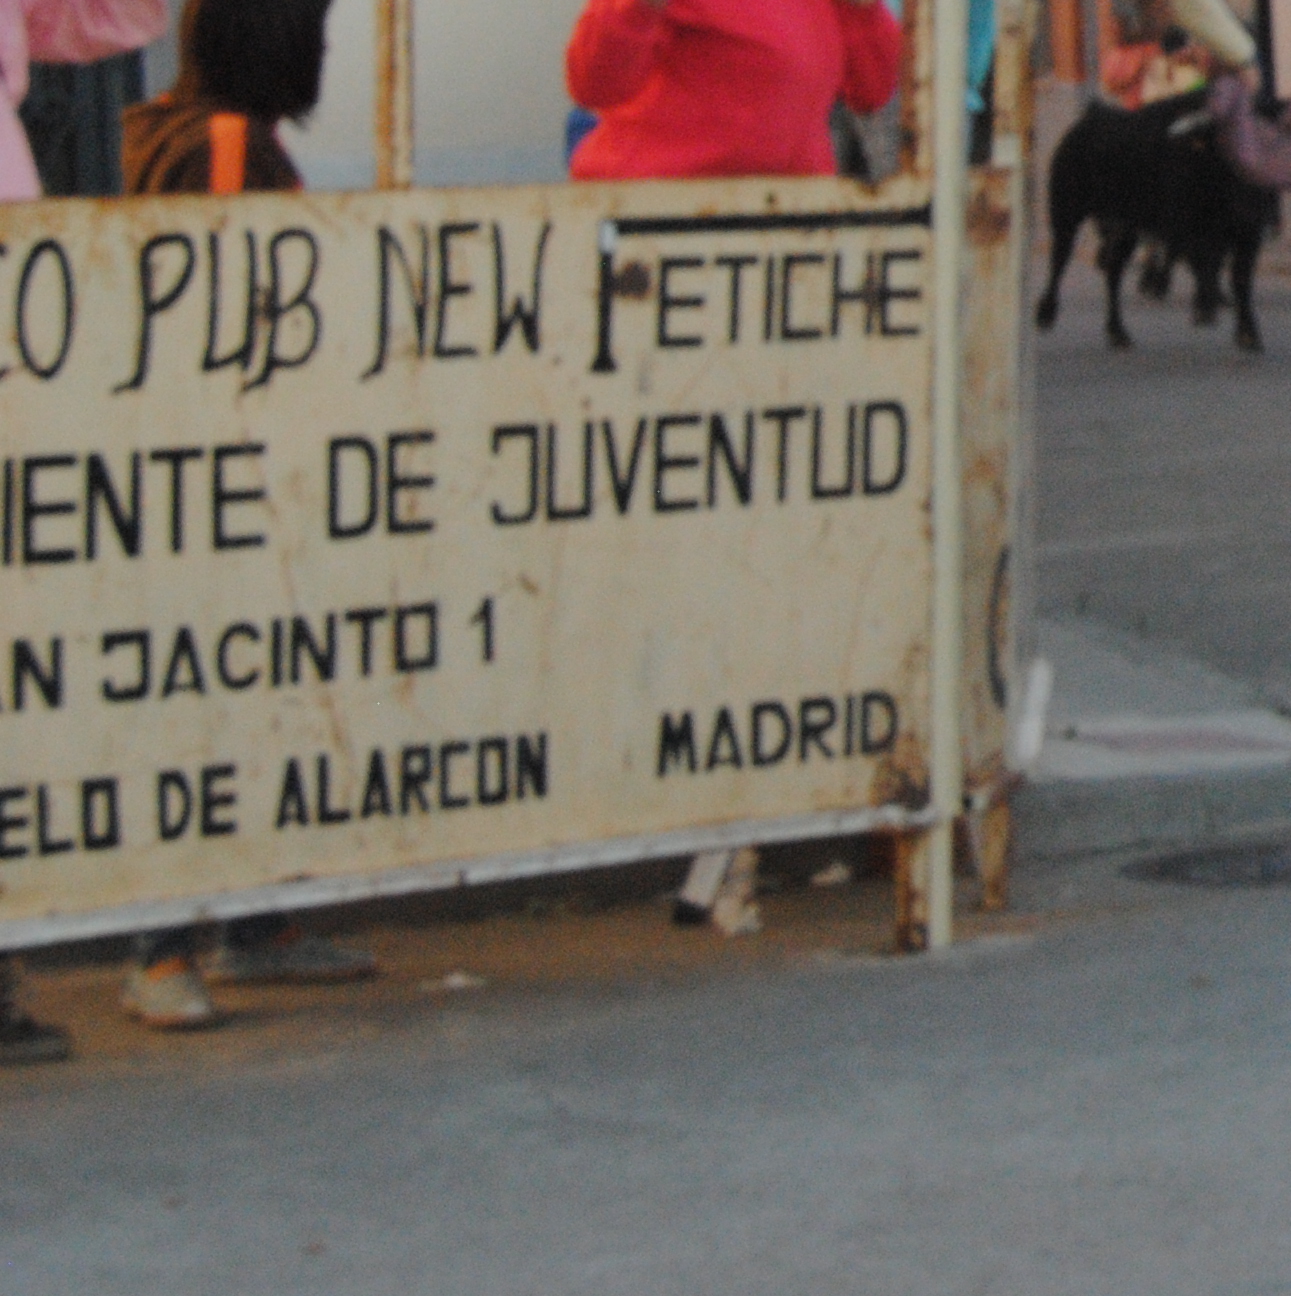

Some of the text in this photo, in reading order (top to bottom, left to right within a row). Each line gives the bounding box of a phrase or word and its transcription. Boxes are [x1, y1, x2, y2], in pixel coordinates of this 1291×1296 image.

[0, 206, 934, 394] O PUB NEW FETICHE
[328, 426, 435, 540] DE
[490, 399, 908, 527] JUVENTUD
[0, 598, 496, 711] N JACINTO 1
[157, 762, 239, 844] DE
[275, 732, 549, 830] ALARCON
[656, 690, 898, 780] MADRID
